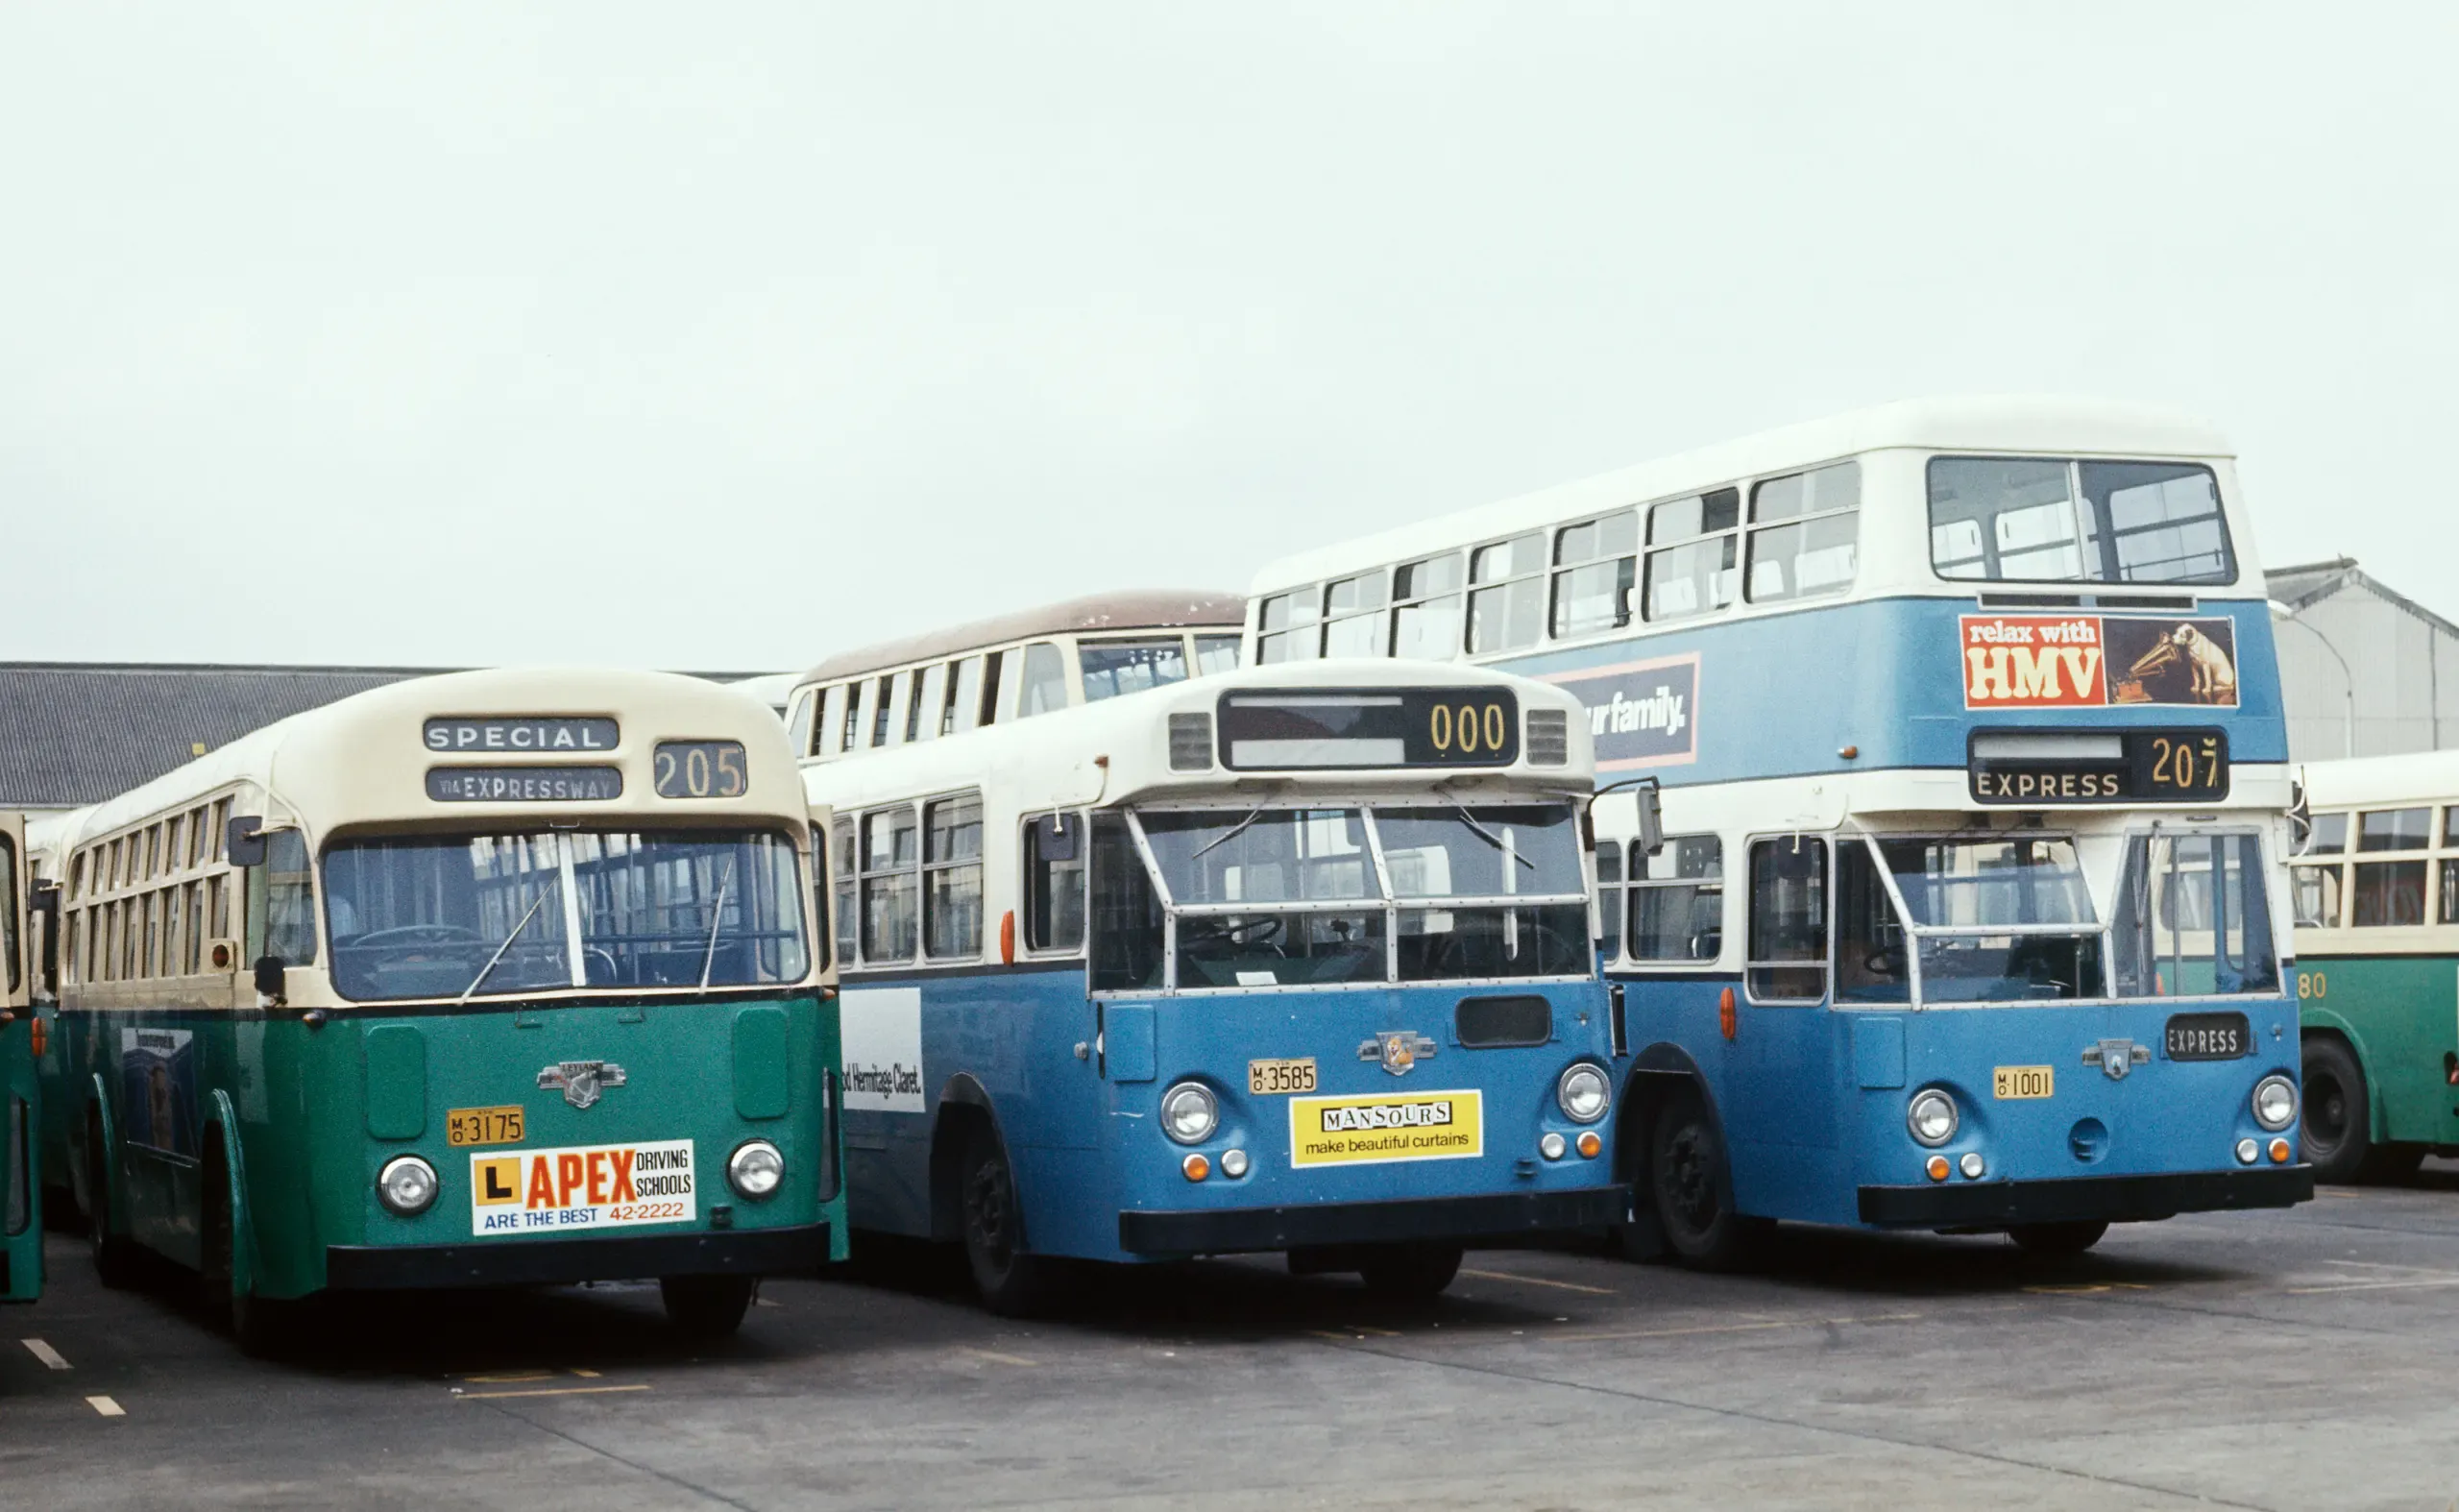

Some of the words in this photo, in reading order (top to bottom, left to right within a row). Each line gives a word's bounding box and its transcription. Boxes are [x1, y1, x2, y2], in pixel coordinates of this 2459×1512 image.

[1969, 620, 2034, 644] relax
[2039, 620, 2097, 644] with
[1966, 646, 2102, 699] HMV
[1610, 686, 1686, 737] family.
[428, 727, 602, 747] SPECIAL
[1430, 703, 1505, 753] 000
[655, 747, 742, 797] 205
[1976, 771, 2119, 797] EXPRESS
[439, 780, 460, 795] VIA
[463, 776, 611, 800] EXPRESSWAY
[2297, 971, 2326, 999] 80
[2168, 1029, 2238, 1054] EXPRESS
[852, 1062, 893, 1100] Hermitage
[1327, 1103, 1448, 1130] MANSOURS
[1305, 1137, 1345, 1155] make
[1348, 1134, 1409, 1153] beautiful
[1412, 1132, 1470, 1149] curtains
[636, 1149, 689, 1172] DRIVING
[485, 1166, 512, 1200] L
[525, 1148, 639, 1210] APEX
[636, 1174, 692, 1197] SCHOOLS
[484, 1212, 520, 1230] ARE
[523, 1210, 554, 1227] THE
[559, 1207, 598, 1225] BEST
